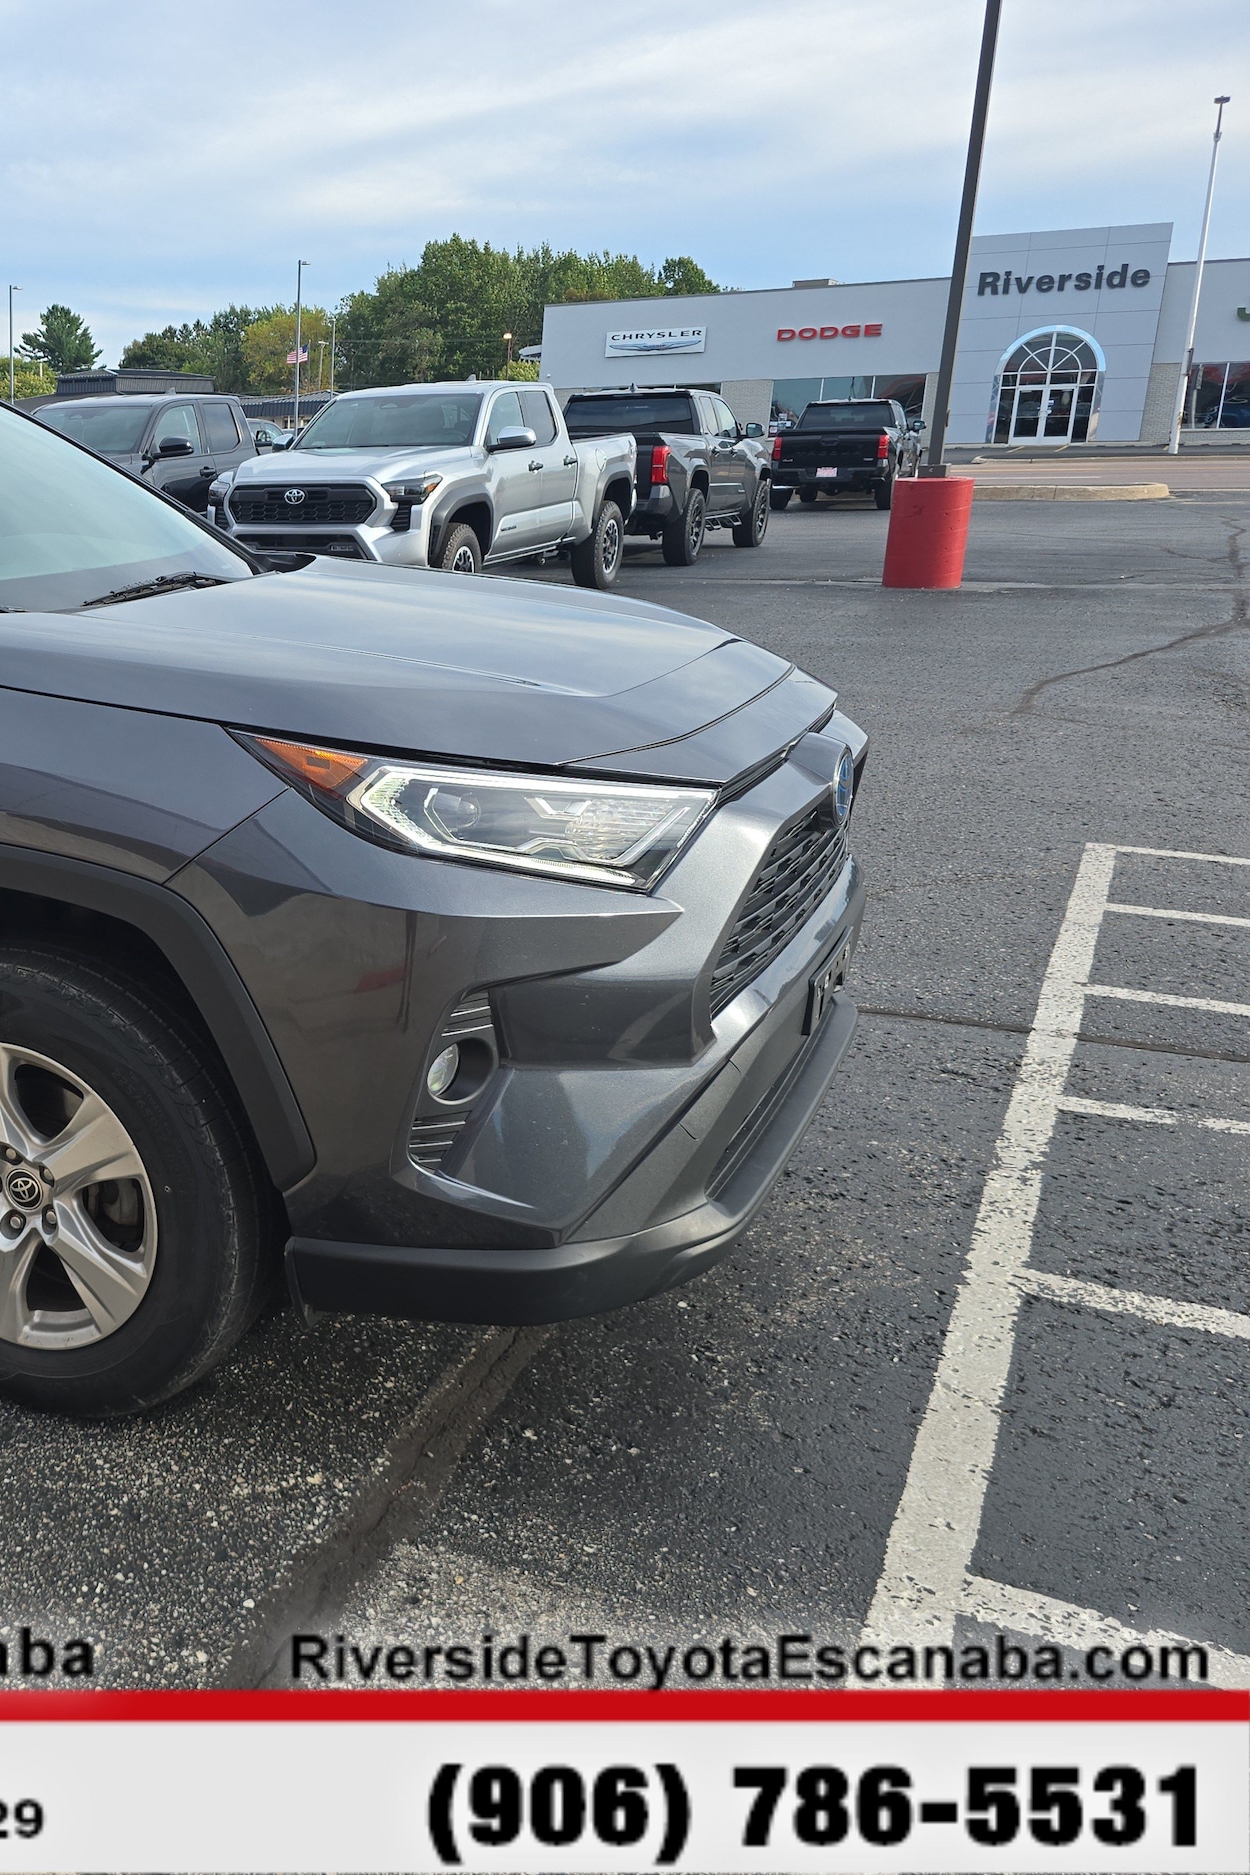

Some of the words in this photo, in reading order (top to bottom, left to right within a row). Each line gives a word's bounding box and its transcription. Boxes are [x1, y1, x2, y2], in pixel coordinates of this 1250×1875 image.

[977, 263, 1150, 296] Riverside
[611, 329, 702, 341] CHRYSLER
[777, 324, 883, 341] DODGE
